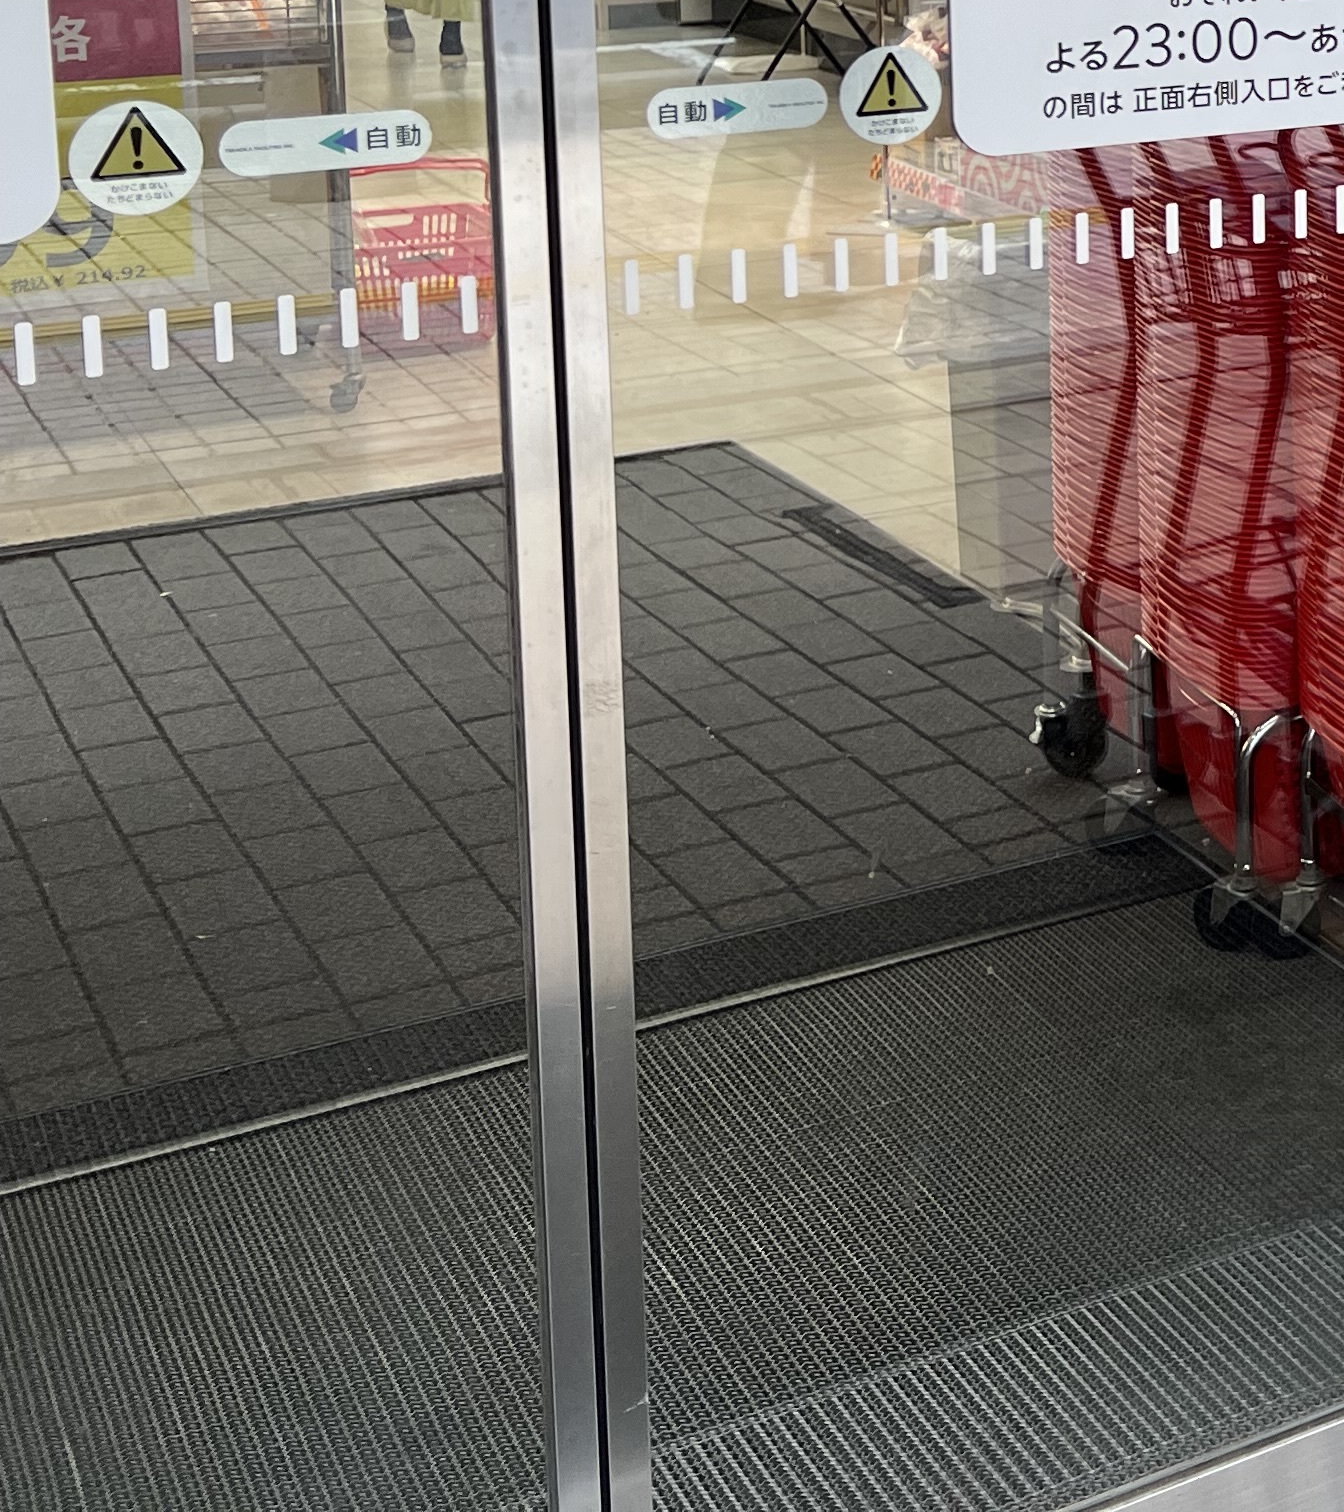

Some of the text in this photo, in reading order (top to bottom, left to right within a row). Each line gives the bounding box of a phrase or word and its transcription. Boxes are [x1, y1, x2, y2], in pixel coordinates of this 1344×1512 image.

[658, 100, 707, 126] 自動
[1042, 88, 1123, 120] の間は
[366, 123, 422, 151] 自動
